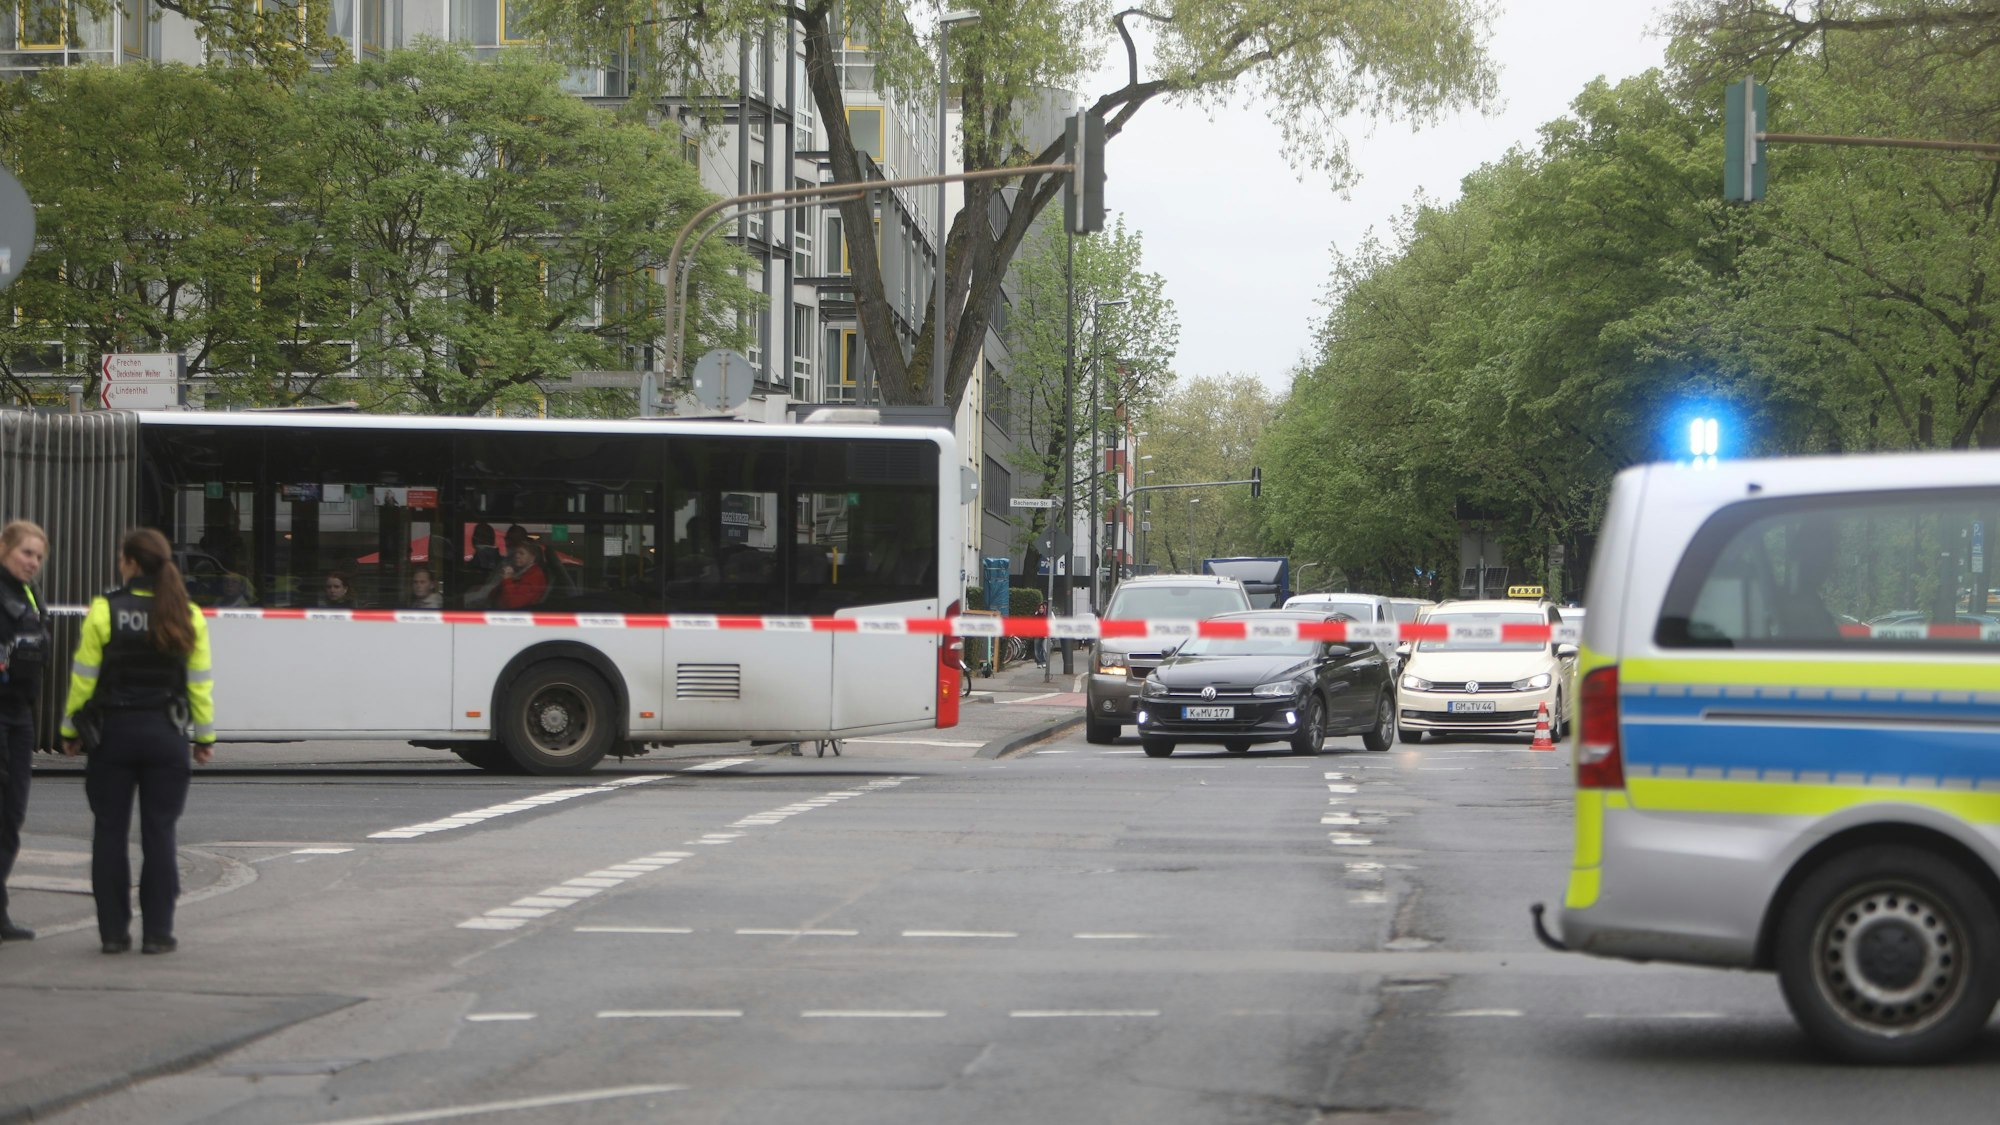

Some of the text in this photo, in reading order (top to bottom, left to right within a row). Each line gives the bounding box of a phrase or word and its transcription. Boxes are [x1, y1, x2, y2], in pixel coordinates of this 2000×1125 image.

[116, 358, 173, 367] Frechen 11
[116, 369, 143, 378] Decksteiner
[144, 369, 161, 378] Weiher
[115, 386, 148, 395] Lindenthal
[117, 609, 149, 632] POL
[1455, 702, 1492, 711] GM TV 44
[1189, 708, 1196, 718] K
[1213, 708, 1230, 718] 177
